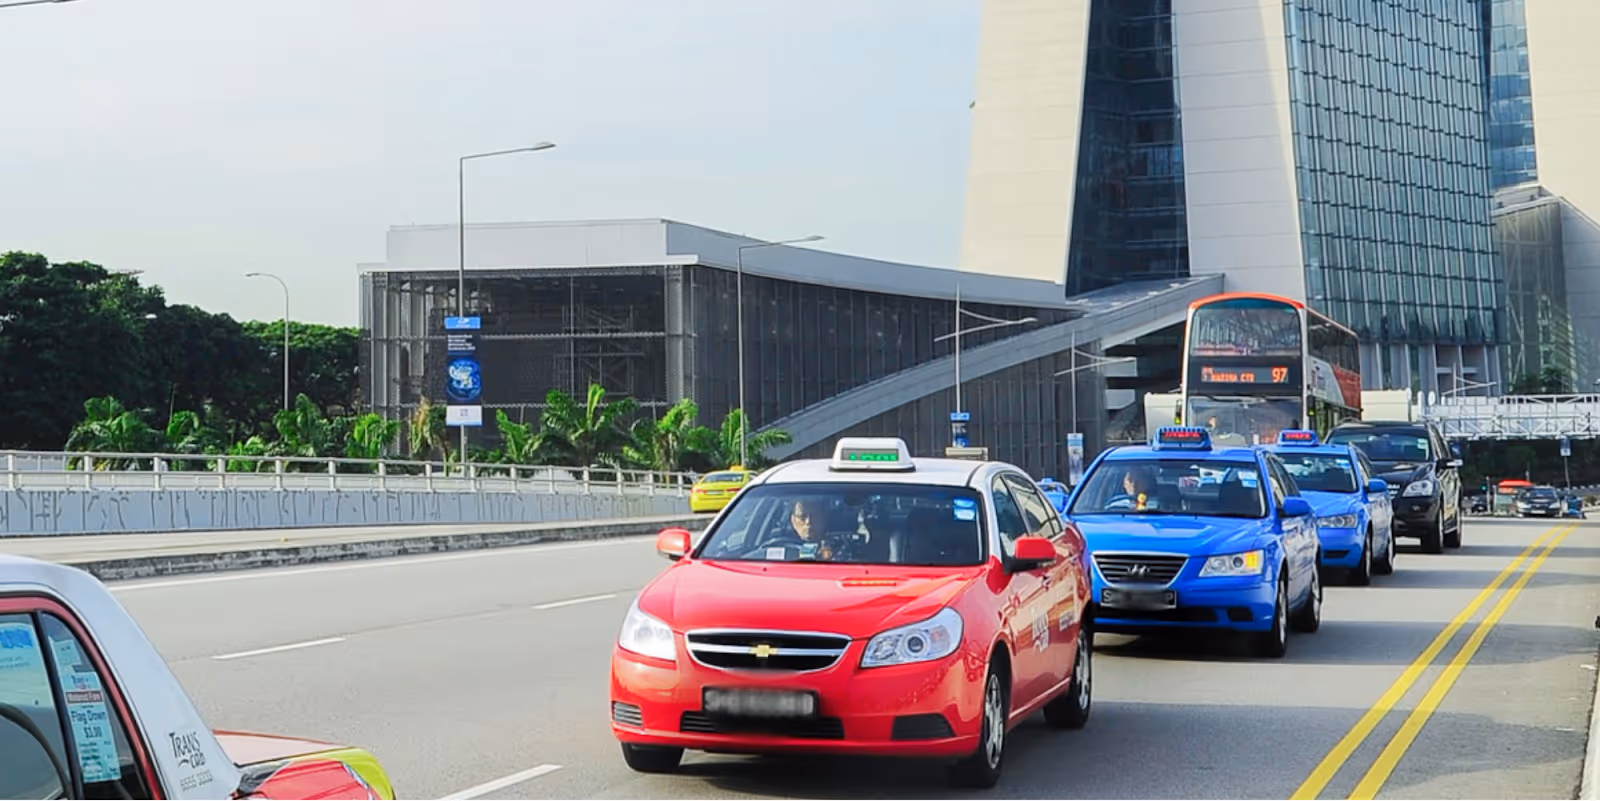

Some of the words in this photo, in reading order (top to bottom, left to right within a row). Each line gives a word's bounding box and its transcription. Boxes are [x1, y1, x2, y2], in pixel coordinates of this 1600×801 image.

[1271, 366, 1288, 382] 97
[71, 710, 88, 725] Flag
[87, 709, 106, 721] Down
[169, 731, 201, 758] TRANS
